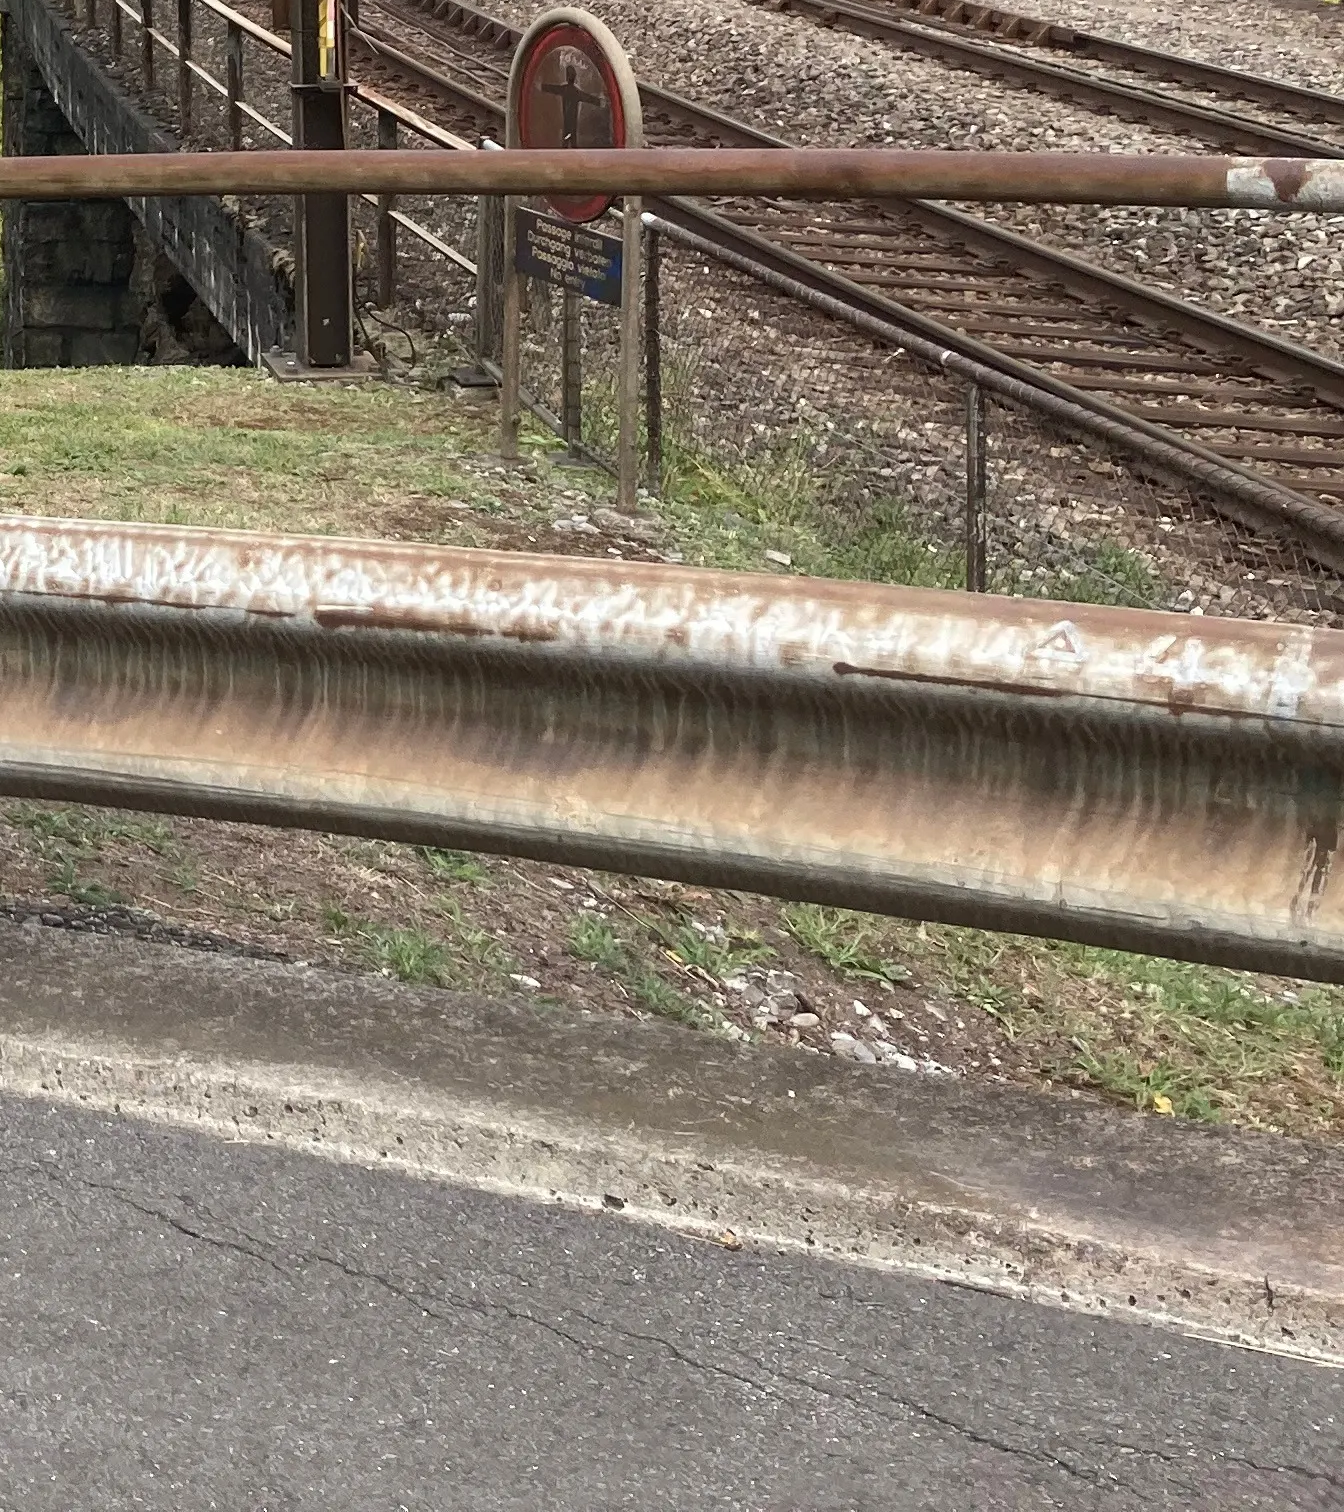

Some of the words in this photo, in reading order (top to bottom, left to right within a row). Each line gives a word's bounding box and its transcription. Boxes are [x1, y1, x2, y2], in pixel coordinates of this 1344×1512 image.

[536, 218, 572, 242] Passage
[527, 229, 571, 258] Durchgang
[532, 245, 574, 271] Passaggio
[550, 267, 562, 280] No
